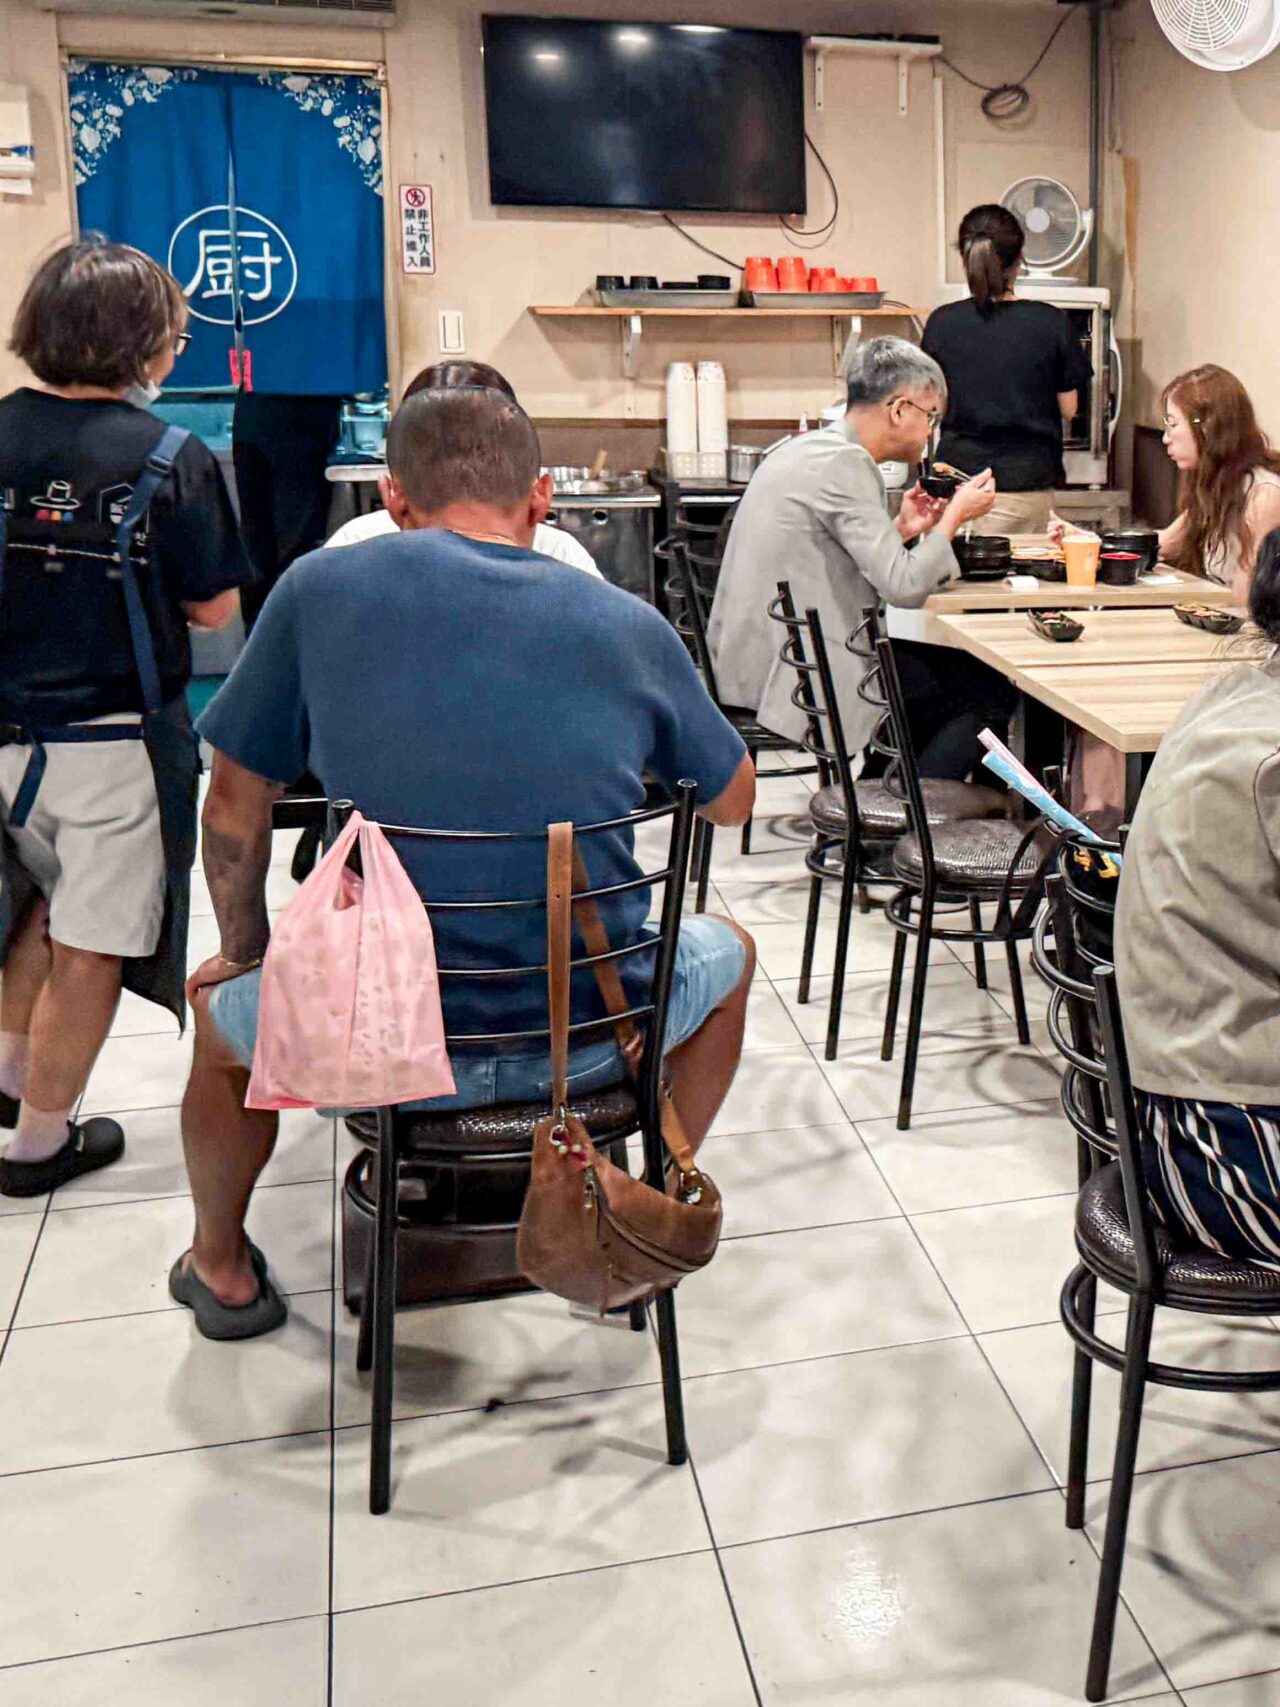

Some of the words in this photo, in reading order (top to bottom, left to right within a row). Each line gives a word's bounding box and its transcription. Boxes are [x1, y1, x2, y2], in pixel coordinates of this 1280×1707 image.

[404, 208, 418, 268] 禁止進入
[417, 208, 431, 268] 非工作人員
